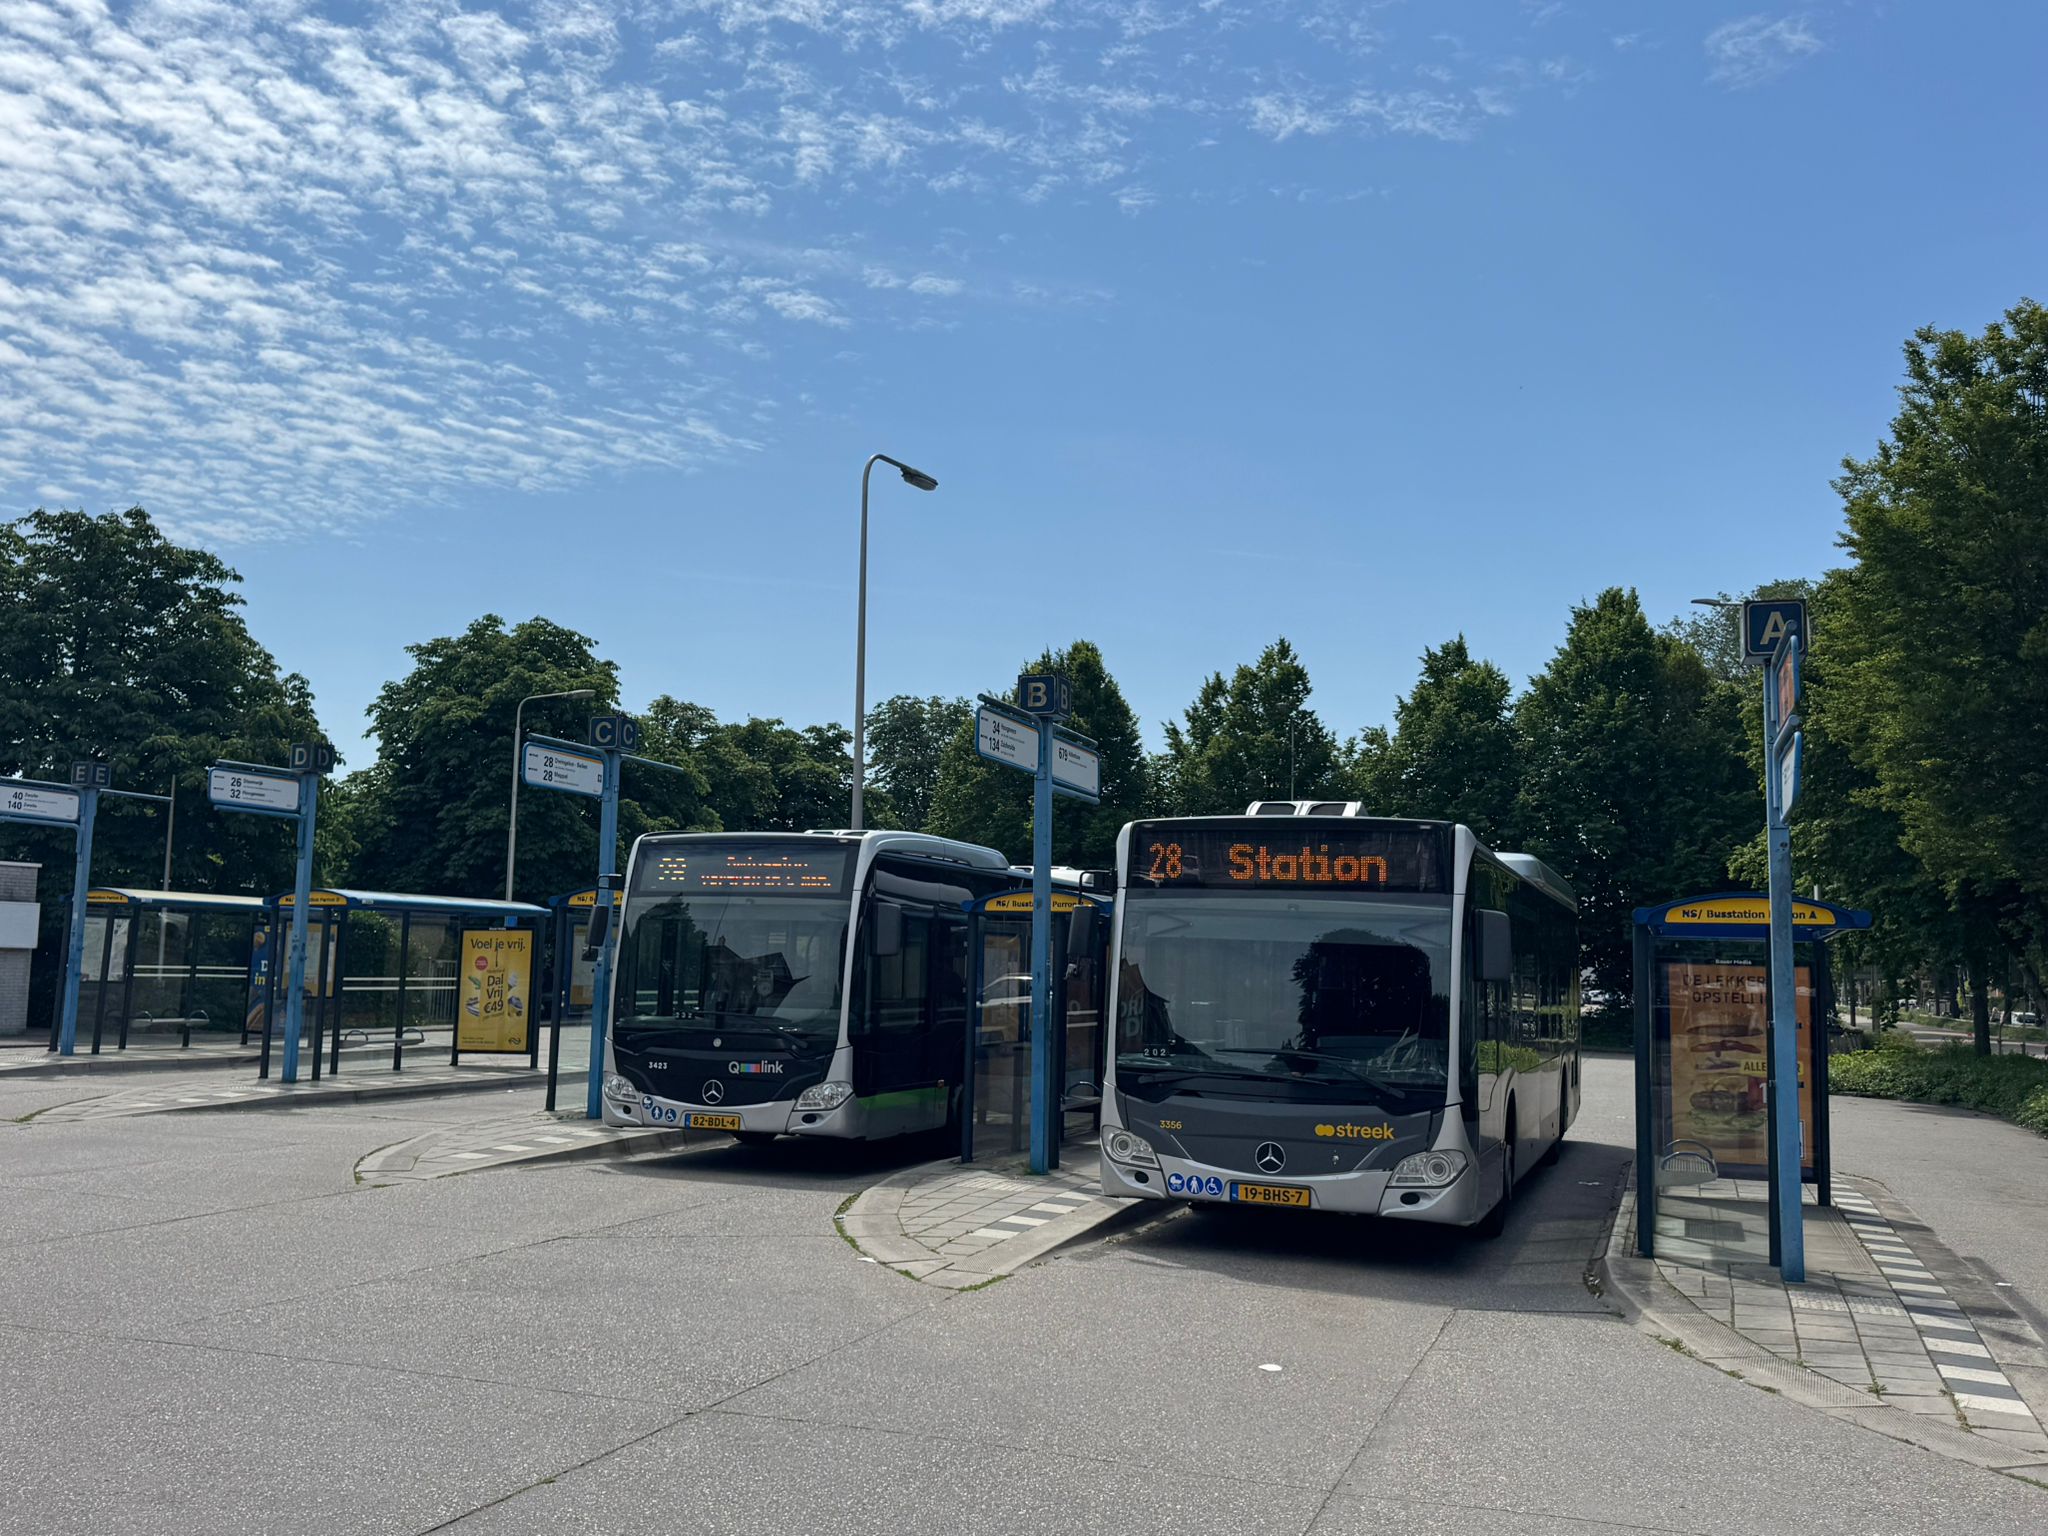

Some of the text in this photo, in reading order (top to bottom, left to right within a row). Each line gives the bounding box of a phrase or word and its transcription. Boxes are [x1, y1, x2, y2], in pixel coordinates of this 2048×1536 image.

[1760, 611, 1787, 645] A
[1028, 682, 1047, 708] B
[1061, 683, 1068, 710] B
[595, 721, 612, 743] C
[623, 723, 634, 745] C
[992, 720, 1000, 736] 34
[989, 737, 1000, 752] 134
[295, 748, 307, 765] D
[318, 749, 329, 766] D
[543, 755, 554, 768] 28
[76, 765, 86, 781] E
[96, 767, 106, 783] E
[543, 770, 553, 782] 28
[230, 777, 242, 787] 26
[12, 791, 23, 800] 40
[230, 789, 241, 799] 32
[8, 800, 22, 810] 140
[1150, 843, 1388, 882] 28 Station
[1682, 909, 1703, 920] NS/
[1706, 909, 1766, 920] Busstation
[1808, 910, 1818, 920] A
[471, 938, 492, 950] Voel
[507, 938, 526, 952] vrij.
[487, 974, 504, 987] Dal
[487, 985, 503, 1000] Vrij
[484, 999, 504, 1014] €49
[649, 1061, 668, 1070] 3423
[692, 1116, 736, 1128] 82-BDL-4
[1159, 1119, 1395, 1140] 3356 streek
[1243, 1186, 1304, 1203] 19-BHS-7
